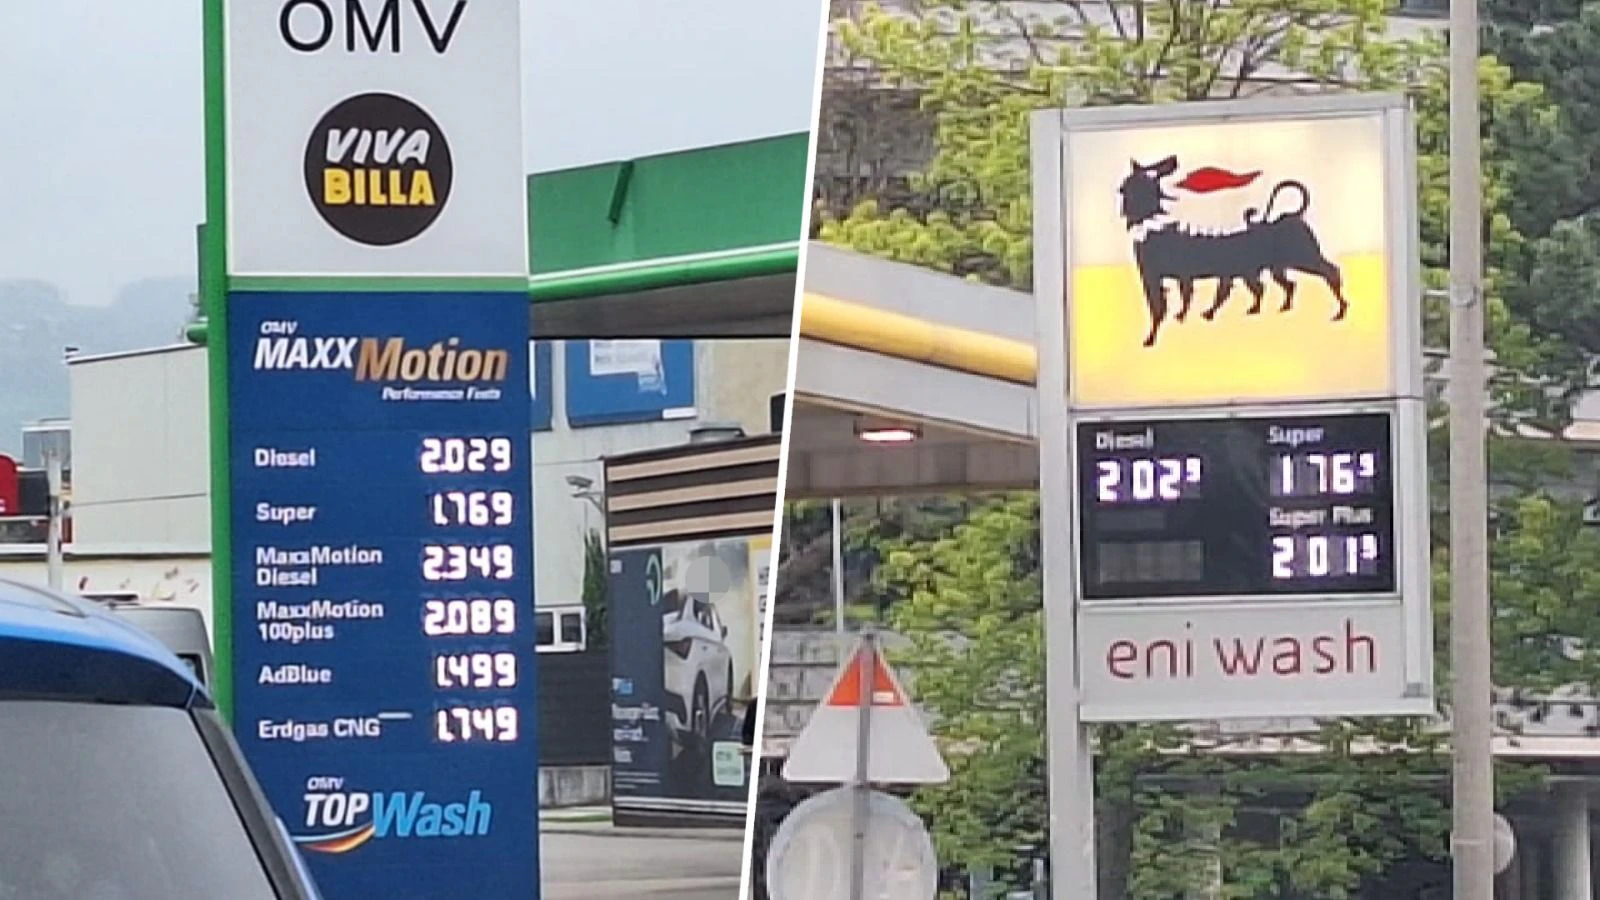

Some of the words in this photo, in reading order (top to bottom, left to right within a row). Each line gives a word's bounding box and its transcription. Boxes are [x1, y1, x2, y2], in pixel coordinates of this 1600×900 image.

[279, 0, 467, 53] OMV
[325, 127, 431, 165] VIVA
[323, 168, 436, 206] BILLA
[260, 321, 298, 335] OMV
[1266, 425, 1325, 446] Super
[255, 448, 316, 467] Diesel
[256, 503, 317, 526] Super
[1269, 506, 1327, 529] Super
[256, 545, 384, 566] MaxxMotion
[257, 568, 318, 586] Diesel
[257, 600, 384, 621] MaxxMotion
[259, 622, 335, 644] 100plus
[1107, 621, 1194, 679] eni
[1212, 617, 1376, 676] wash
[258, 665, 332, 684] AdBlue
[259, 720, 328, 742] Erdgas
[333, 718, 381, 737] CNG
